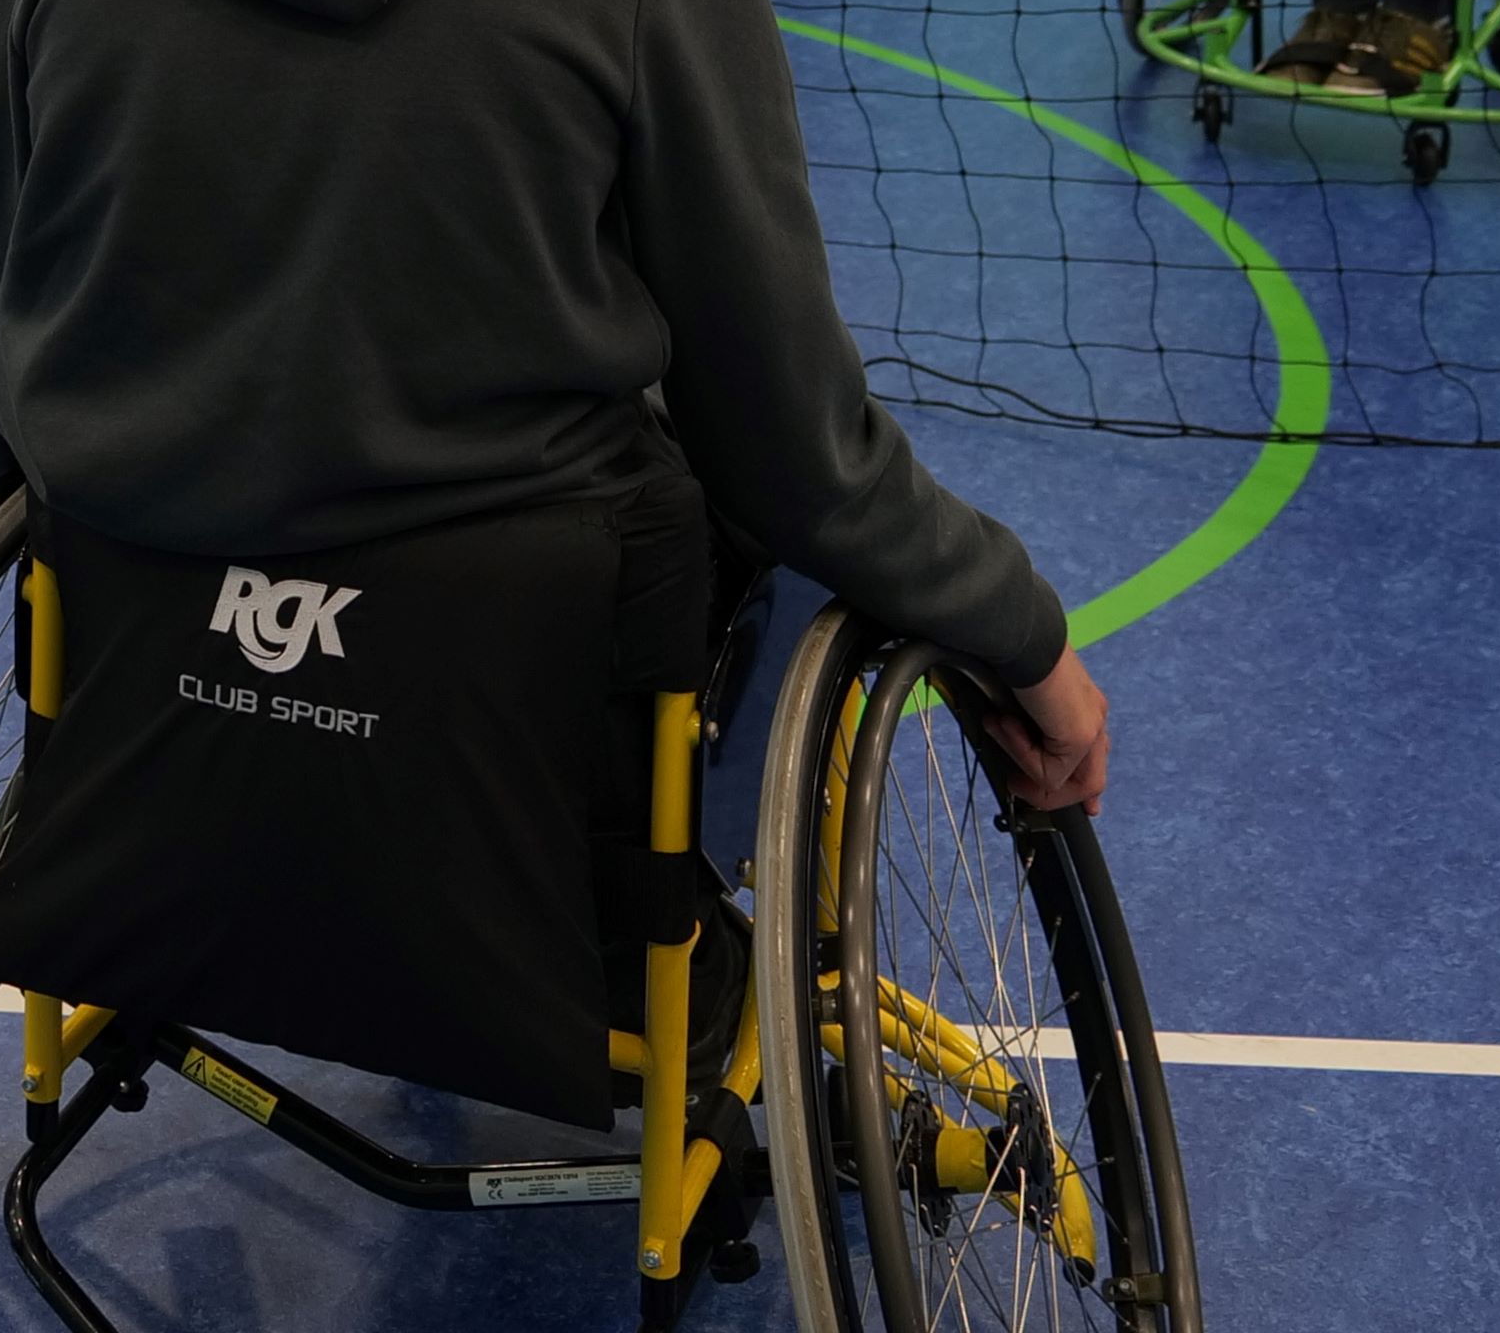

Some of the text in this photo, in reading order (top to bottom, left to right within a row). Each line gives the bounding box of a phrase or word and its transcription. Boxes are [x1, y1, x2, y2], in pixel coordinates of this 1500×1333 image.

[209, 565, 362, 673] RGK
[179, 674, 379, 737] CLUB SPORT
